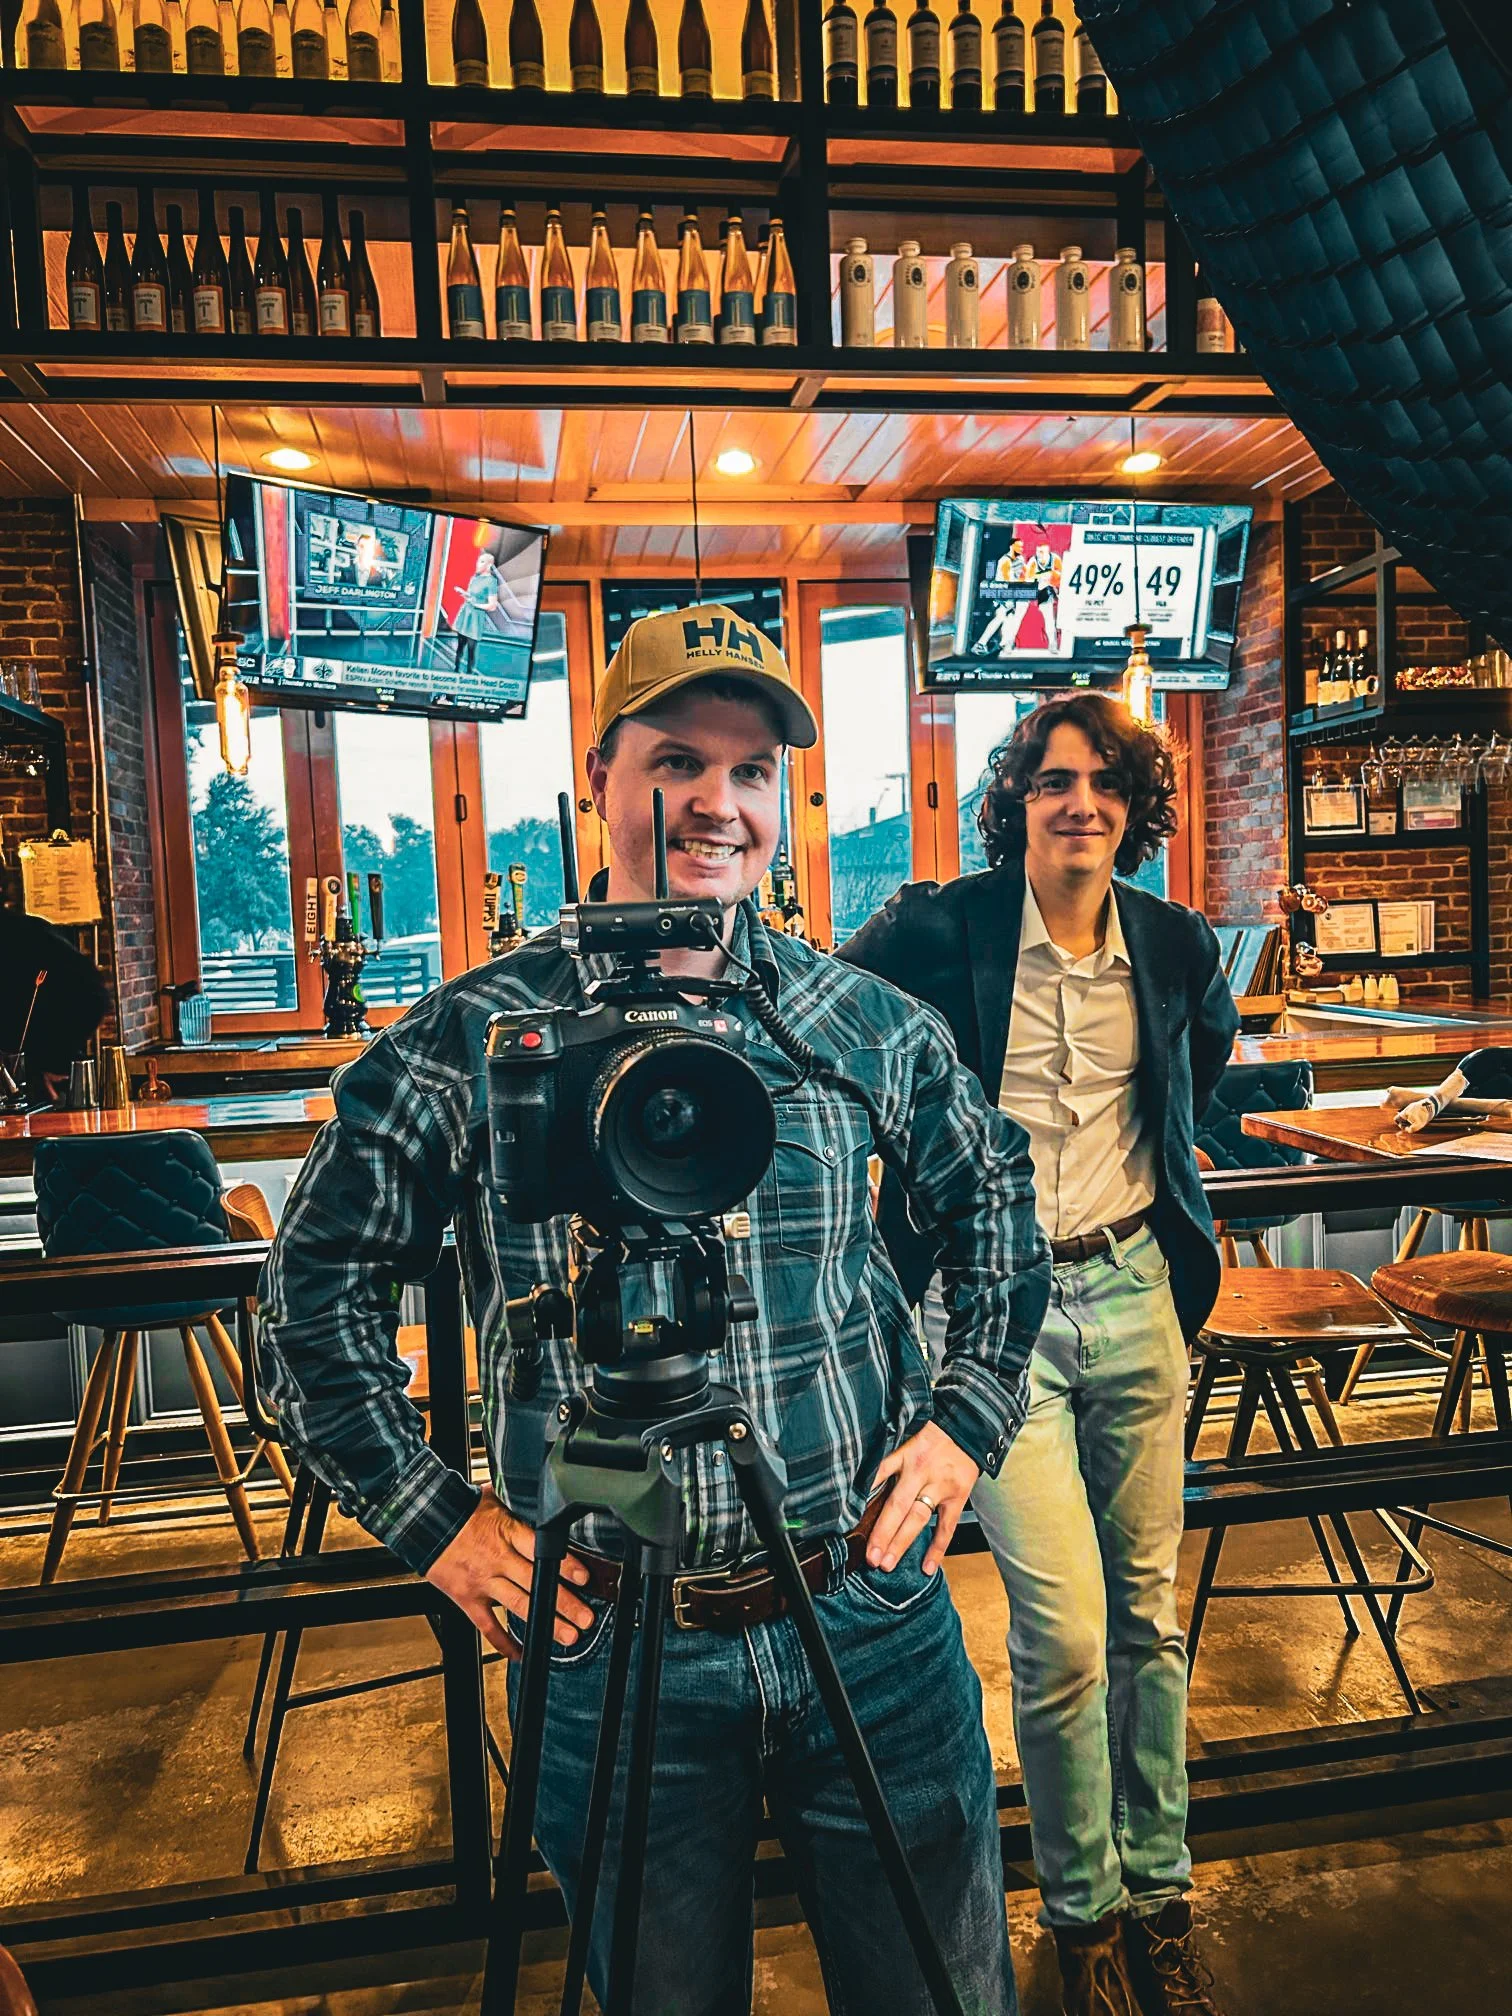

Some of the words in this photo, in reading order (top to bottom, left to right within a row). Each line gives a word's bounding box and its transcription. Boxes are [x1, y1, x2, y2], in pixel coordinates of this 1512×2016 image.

[314, 584, 339, 595] JEFF
[340, 587, 397, 600] DARLINGTON
[1068, 562, 1124, 597] 49%
[1146, 565, 1182, 597] 49
[682, 617, 764, 663] HH
[686, 649, 722, 660] HELLY
[370, 666, 393, 676] Moore
[395, 669, 420, 679] favorite
[422, 672, 430, 680] to
[431, 673, 457, 683] become
[480, 679, 498, 687] Head
[499, 680, 519, 689] Coach
[306, 893, 317, 934] EIGHT
[482, 893, 497, 922] TUPPS
[624, 1009, 678, 1023] Canon
